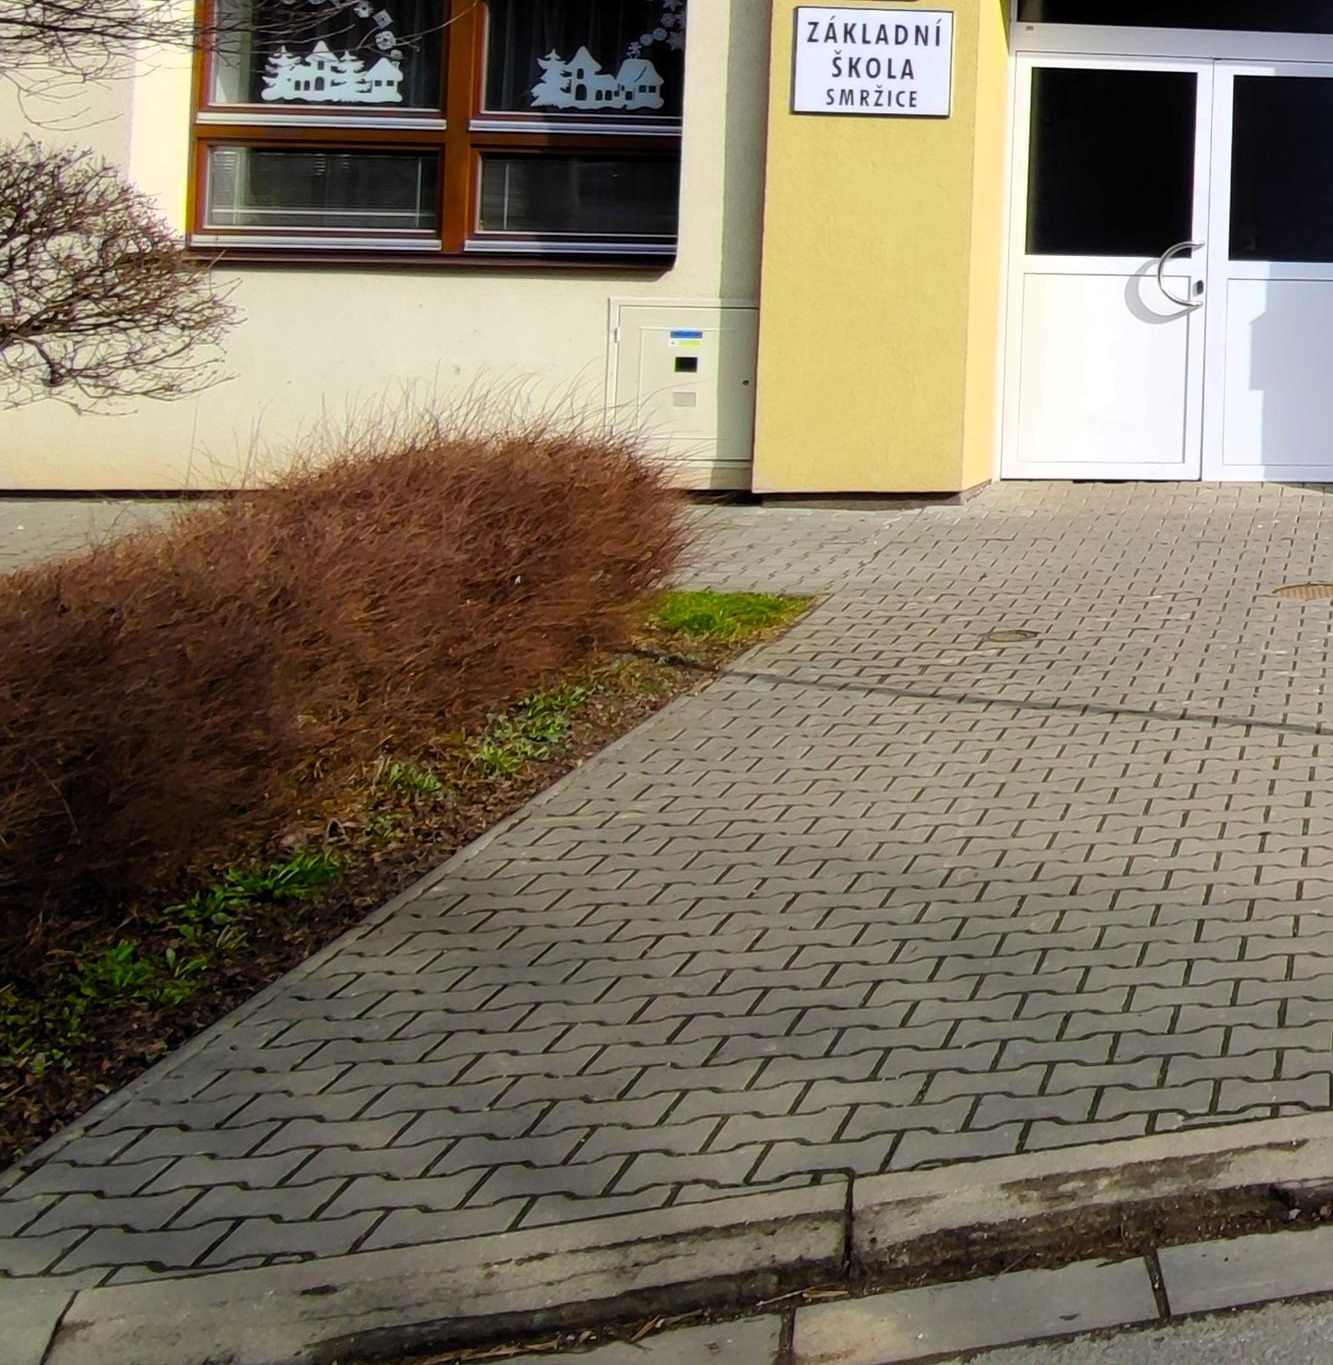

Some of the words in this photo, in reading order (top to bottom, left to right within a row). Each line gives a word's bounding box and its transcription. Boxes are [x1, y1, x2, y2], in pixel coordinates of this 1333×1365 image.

[806, 15, 942, 47] ZÁKLADNÍ
[831, 49, 915, 80] ŠKOLA
[826, 84, 918, 108] SMRŽICE
